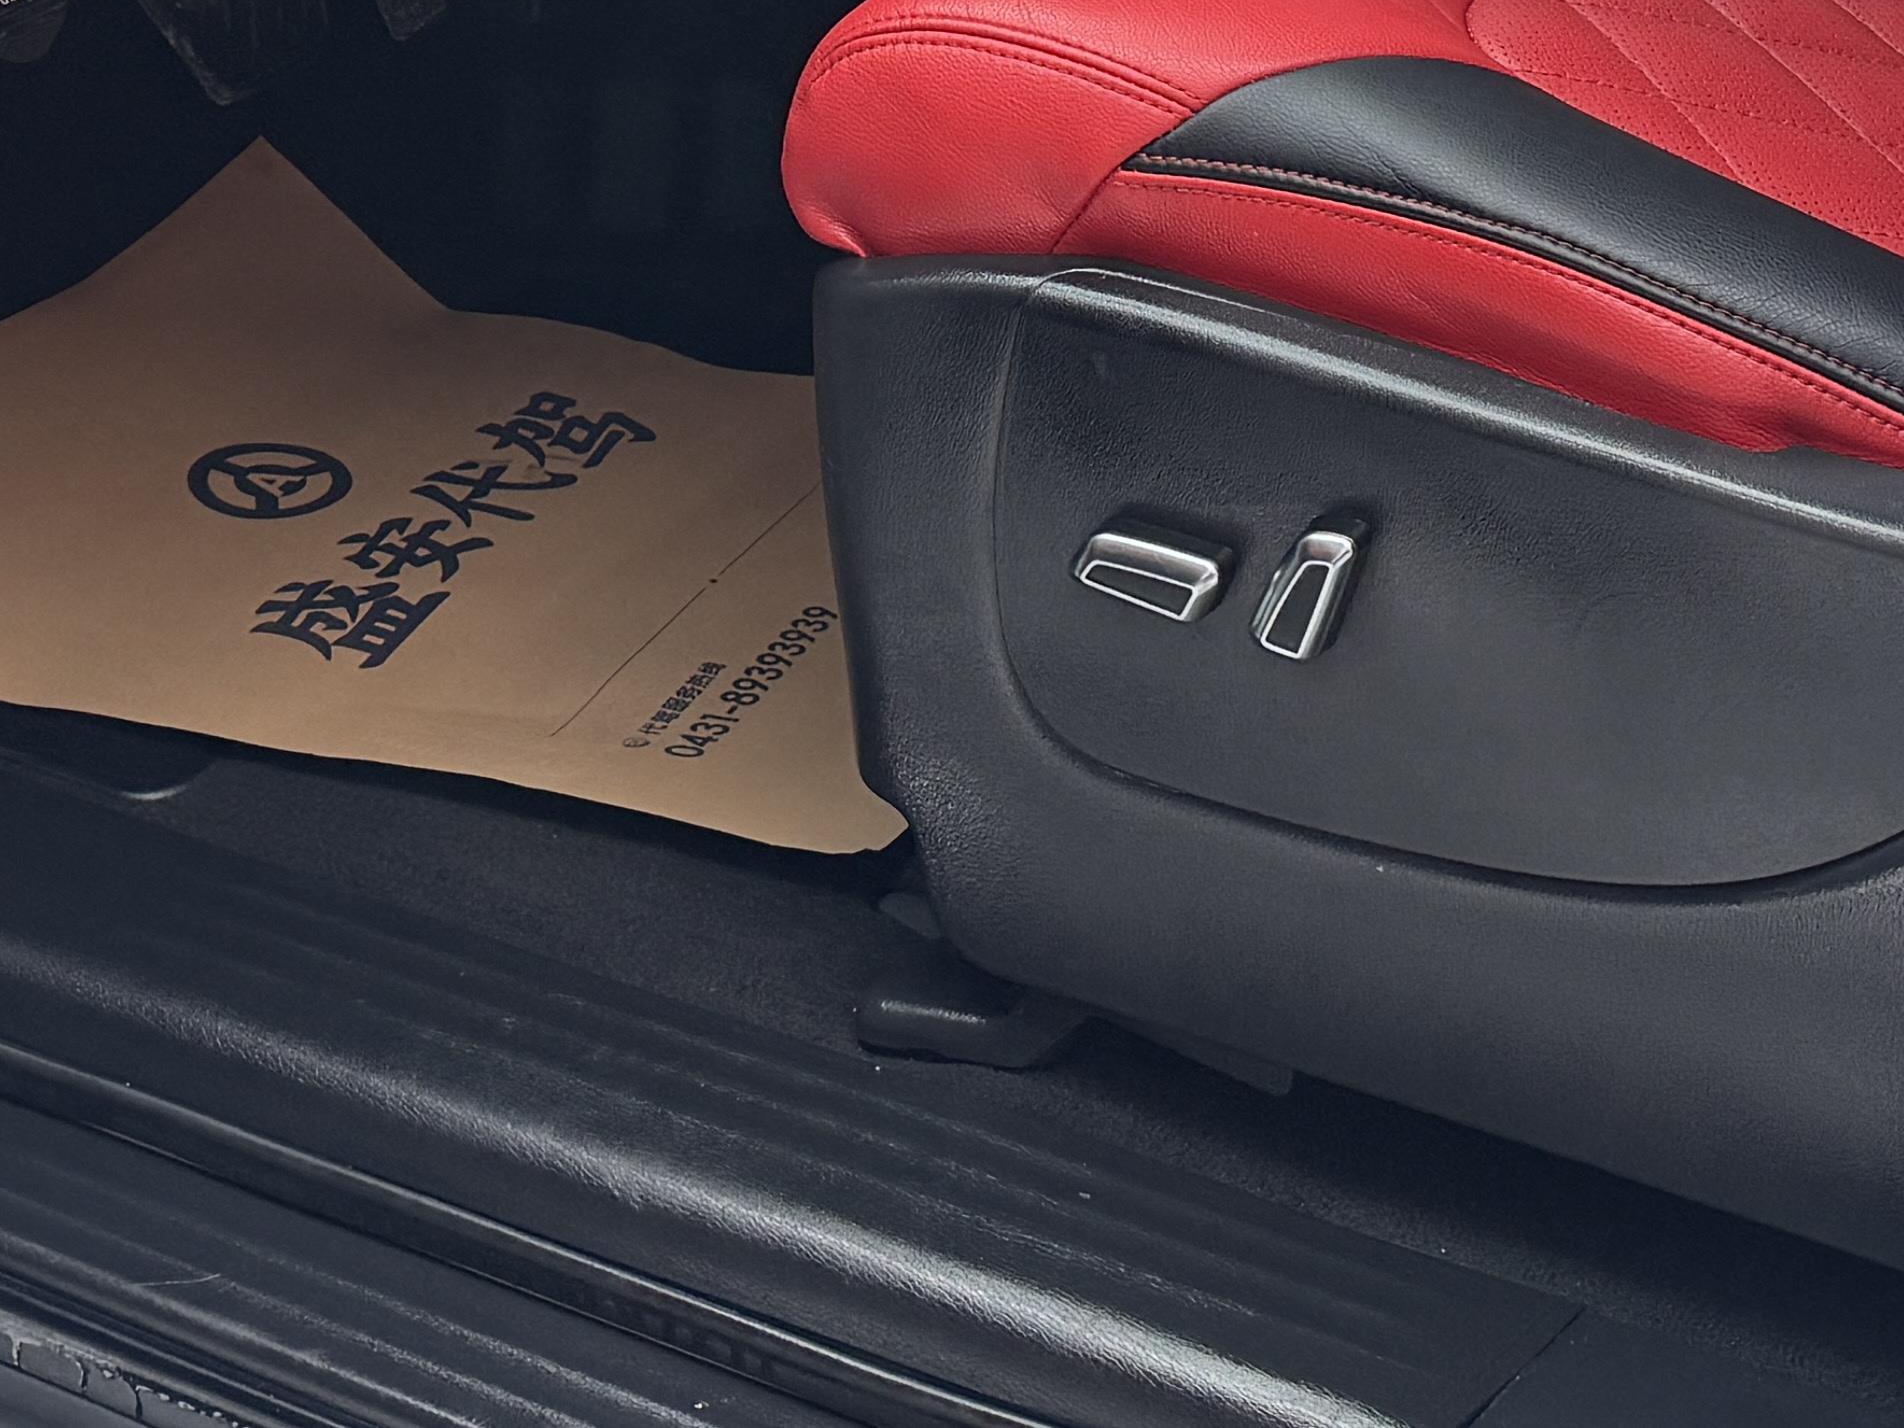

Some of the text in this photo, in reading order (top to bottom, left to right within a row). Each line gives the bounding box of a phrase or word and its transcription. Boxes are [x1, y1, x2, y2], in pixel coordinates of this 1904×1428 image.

[250, 392, 657, 670] 盛安代驾
[663, 605, 839, 759] 0431-89393939
